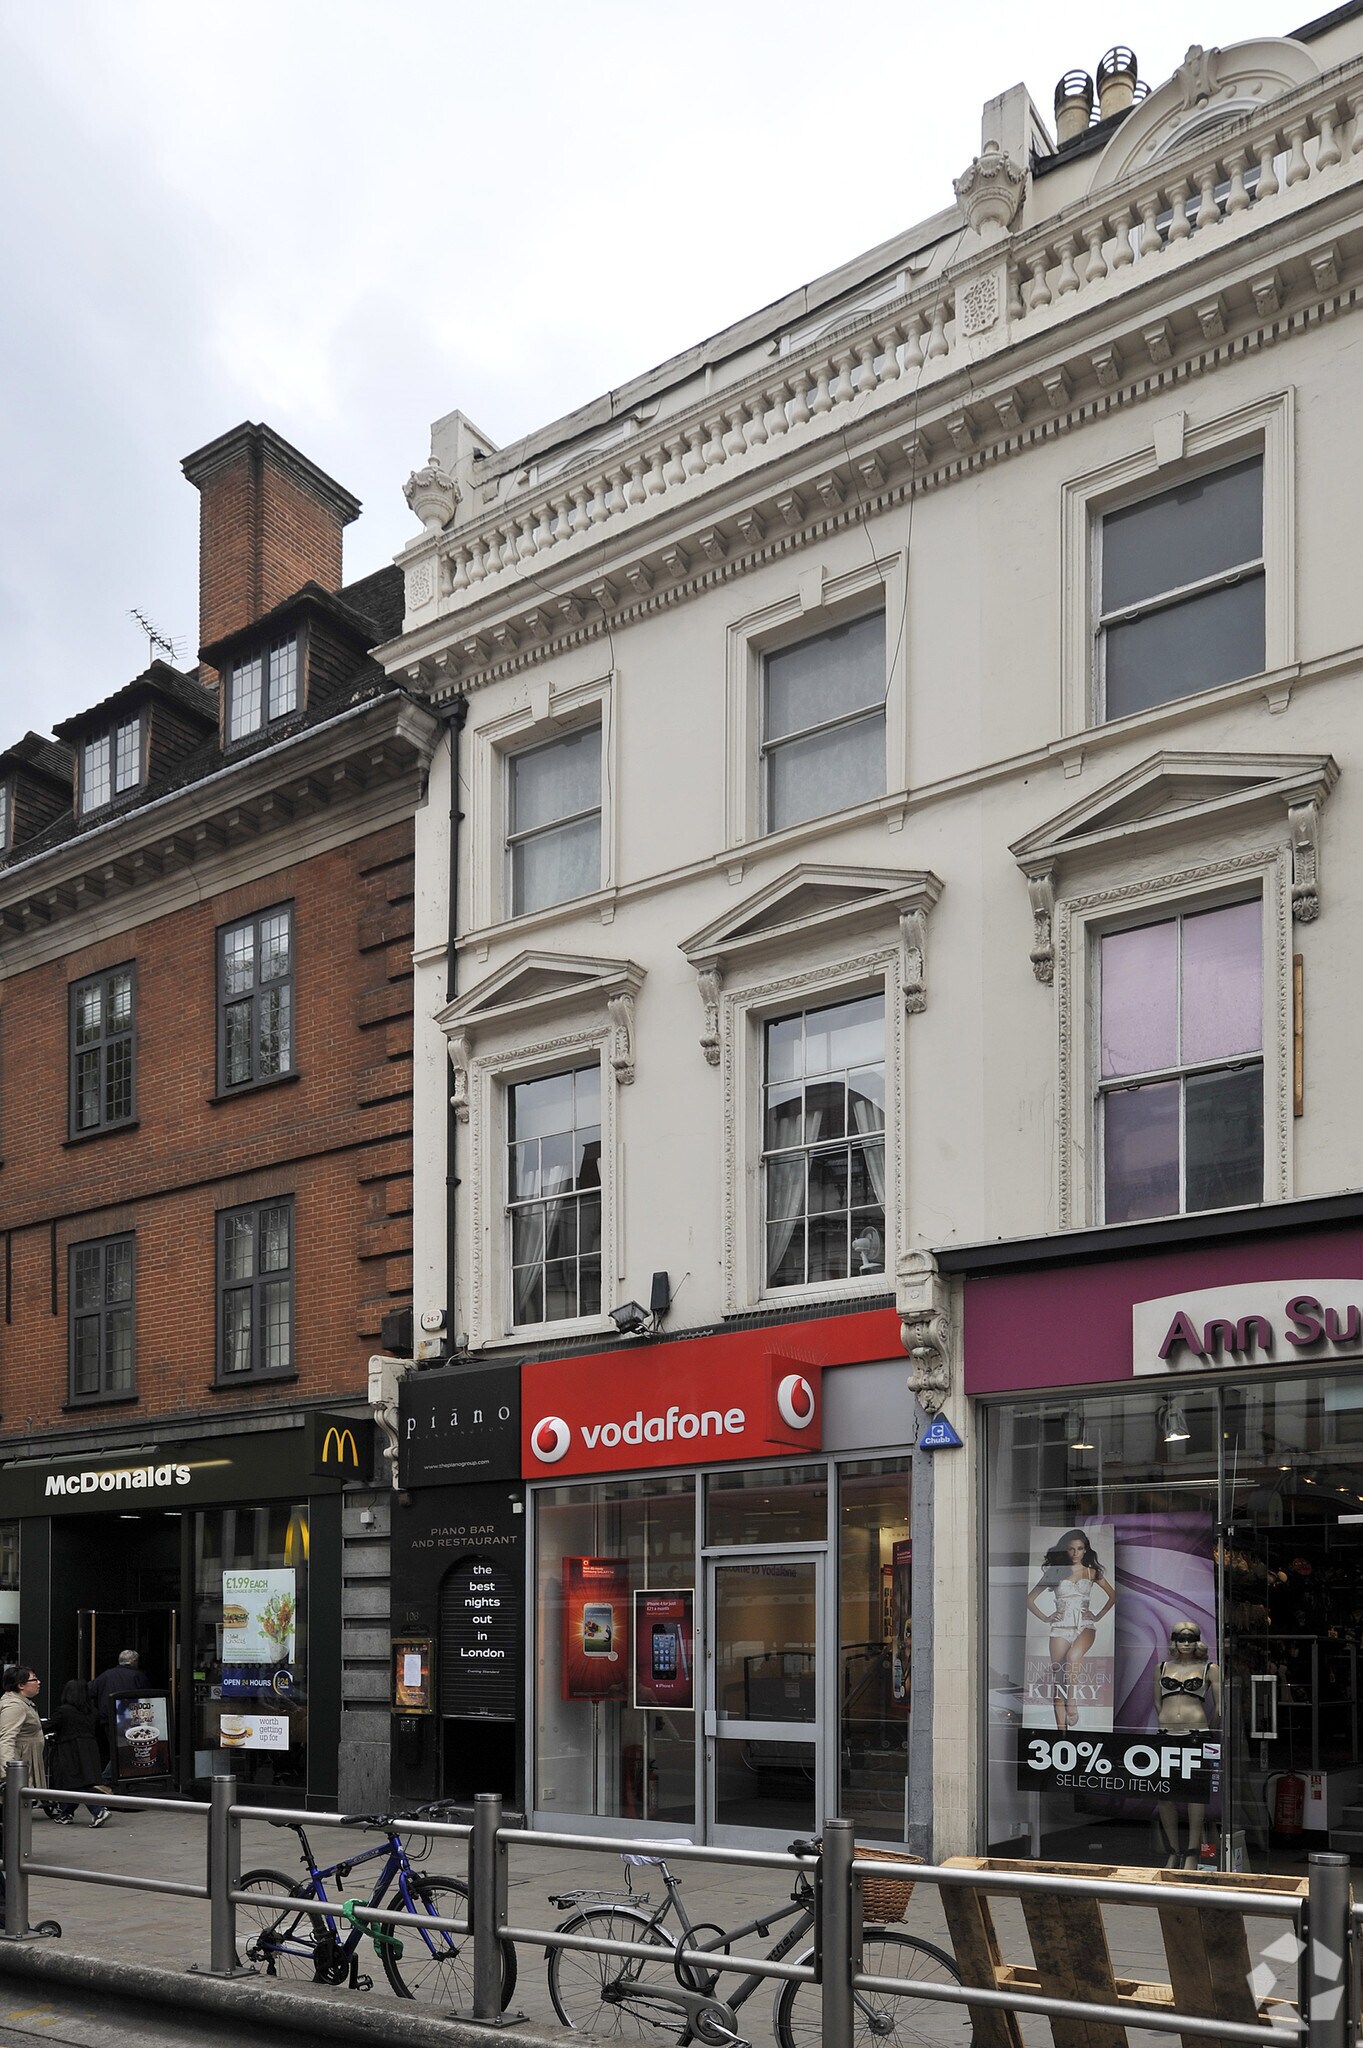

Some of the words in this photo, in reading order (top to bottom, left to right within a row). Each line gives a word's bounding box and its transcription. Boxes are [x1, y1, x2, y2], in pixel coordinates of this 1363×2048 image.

[426, 1315, 440, 1323] 24-7
[1158, 1311, 1270, 1359] Ann
[581, 1406, 746, 1449] vodafone
[925, 1436, 951, 1445] Chubb
[423, 1459, 490, 1470] www.thepianogroup.com
[45, 1464, 191, 1496] McDonald's
[431, 1526, 466, 1536] PIANO
[470, 1525, 495, 1535] BAR
[411, 1540, 435, 1549] AND
[437, 1535, 518, 1547] RESTAURANT
[473, 1565, 492, 1575] the
[226, 1577, 250, 1589] £1.99
[250, 1580, 268, 1588] EACH
[469, 1582, 496, 1592] best
[464, 1597, 501, 1609] nights
[472, 1615, 493, 1624] out
[477, 1632, 488, 1641] in
[460, 1648, 505, 1658] London
[1027, 1661, 1094, 1674] INNOCENT
[280, 1678, 289, 1686] 24
[1027, 1672, 1060, 1684] UNTIL
[1062, 1673, 1112, 1685] PROVEN
[1027, 1683, 1102, 1700] KINKY
[259, 1718, 279, 1726] worth
[259, 1726, 283, 1736] getting
[259, 1734, 269, 1742] up
[269, 1733, 278, 1742] for
[1027, 1739, 1112, 1775] 30%
[1123, 1744, 1202, 1780] OFF
[1056, 1773, 1125, 1791] SELECTED
[1128, 1782, 1171, 1793] ITEMS
